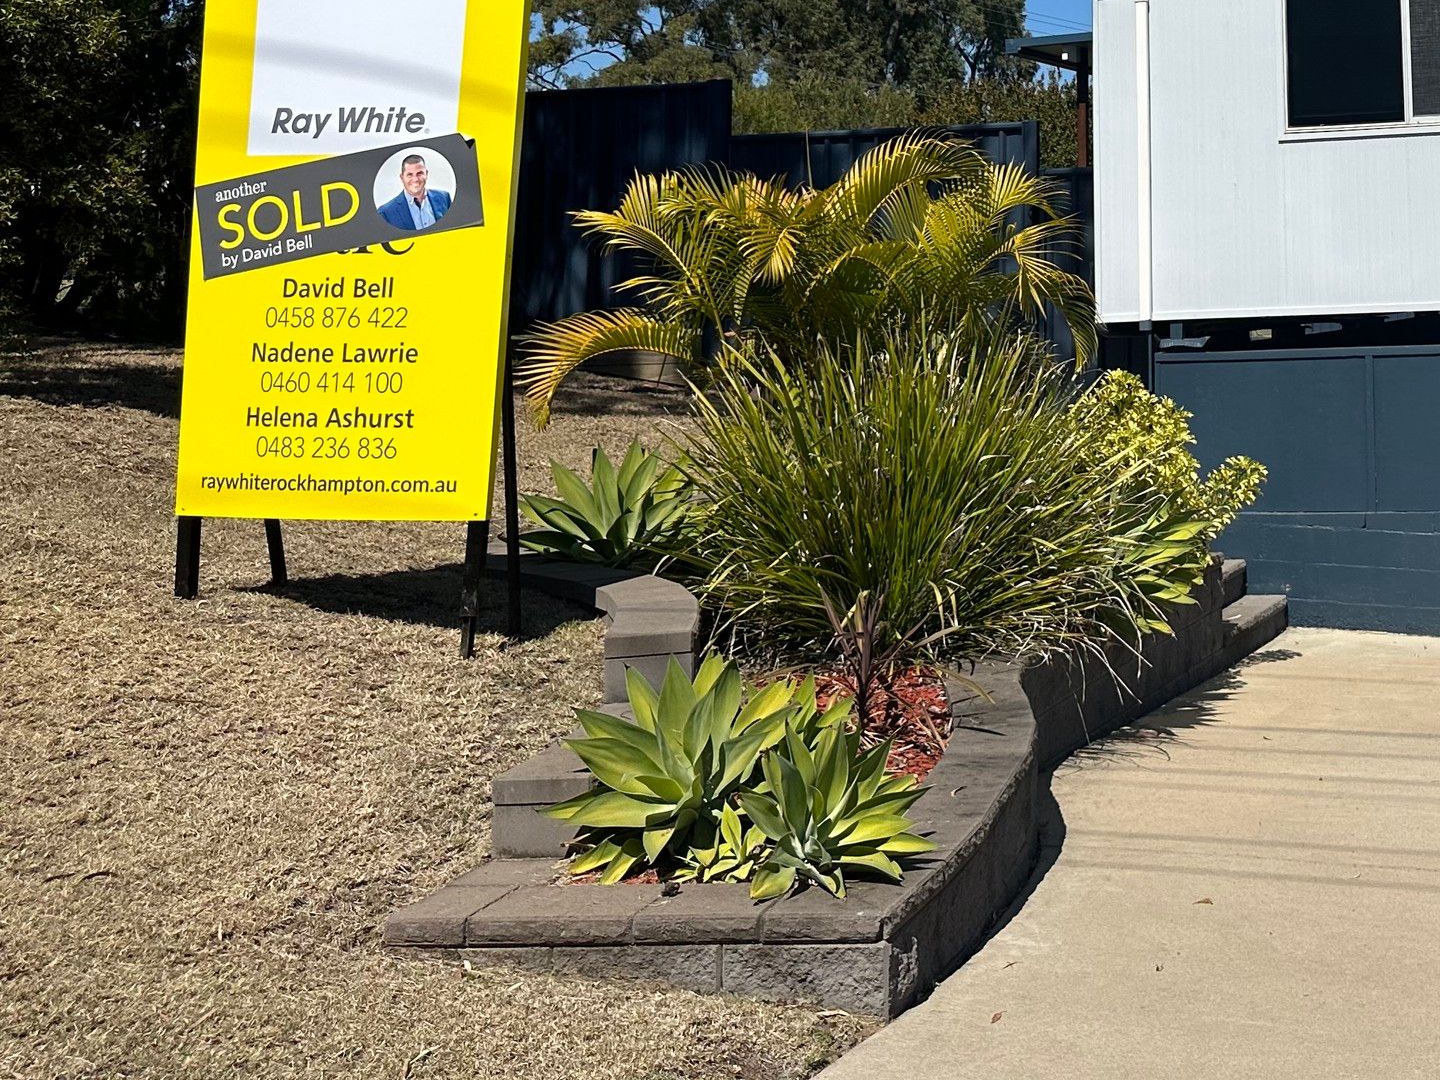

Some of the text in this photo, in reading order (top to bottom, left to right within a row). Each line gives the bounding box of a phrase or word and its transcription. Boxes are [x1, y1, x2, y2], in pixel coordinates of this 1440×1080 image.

[271, 107, 425, 139] Ray White
[215, 181, 267, 202] another
[217, 181, 360, 249] SOLD
[221, 252, 238, 268] by
[242, 241, 282, 263] David
[286, 234, 313, 254] Bell
[283, 277, 394, 298] David Bell
[265, 307, 409, 329] 0458 876 422
[251, 342, 419, 363] Nadene Lawrie
[260, 372, 403, 393] 0460 414 100
[246, 407, 415, 428] Helena Ashurst
[256, 436, 397, 459] 0483 236 836
[201, 473, 457, 496] raywhiterockhampton.com.au
